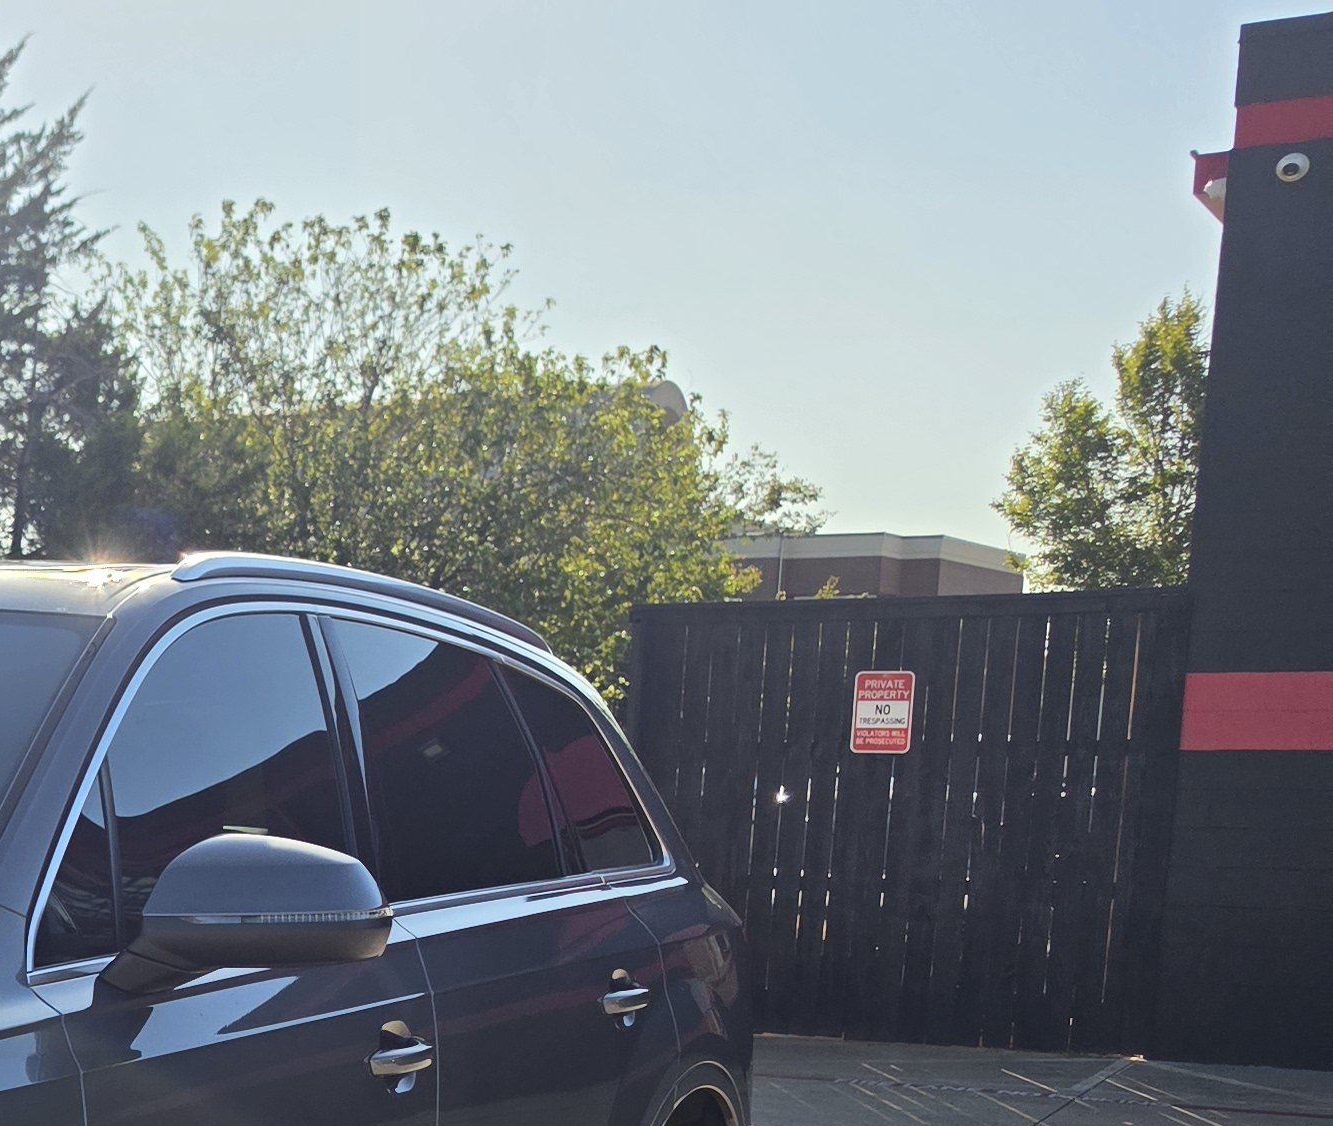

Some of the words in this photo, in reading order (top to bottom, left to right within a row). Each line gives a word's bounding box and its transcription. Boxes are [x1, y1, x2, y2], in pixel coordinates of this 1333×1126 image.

[865, 679, 905, 689] PRIVATE
[858, 690, 910, 699] PROPERTY
[875, 704, 891, 715] NO
[859, 717, 906, 725] TRESPASSING
